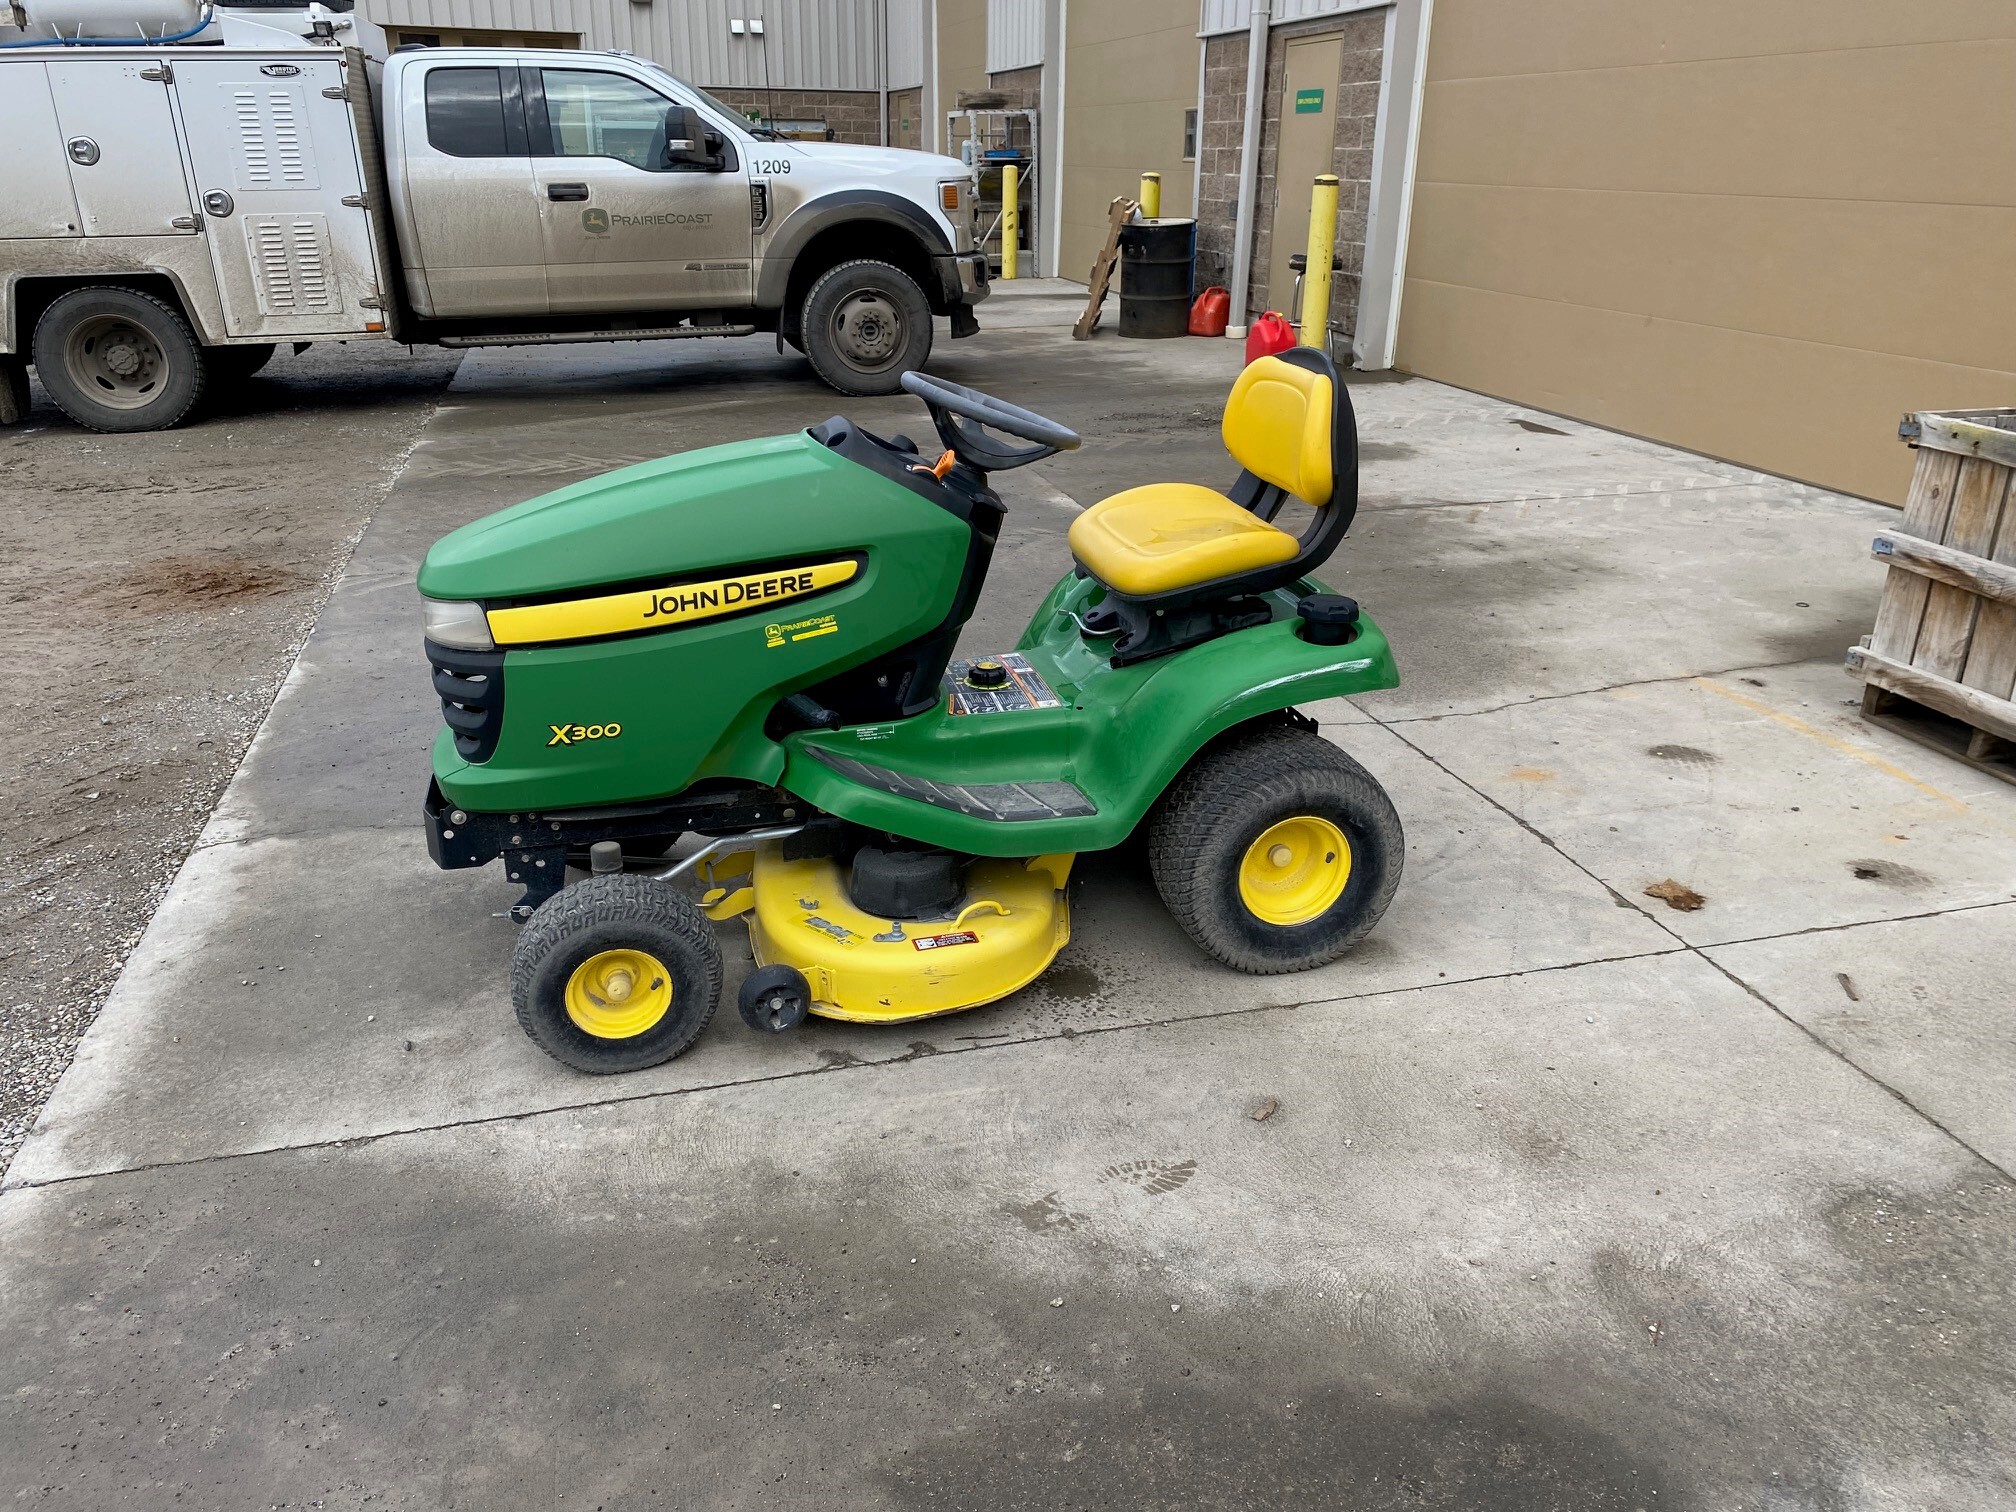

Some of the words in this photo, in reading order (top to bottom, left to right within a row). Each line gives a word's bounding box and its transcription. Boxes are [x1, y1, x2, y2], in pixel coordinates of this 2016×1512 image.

[753, 159, 791, 174] 1209
[643, 589, 719, 618] JOHN
[723, 572, 814, 604] DEERE
[546, 723, 622, 746] X300
